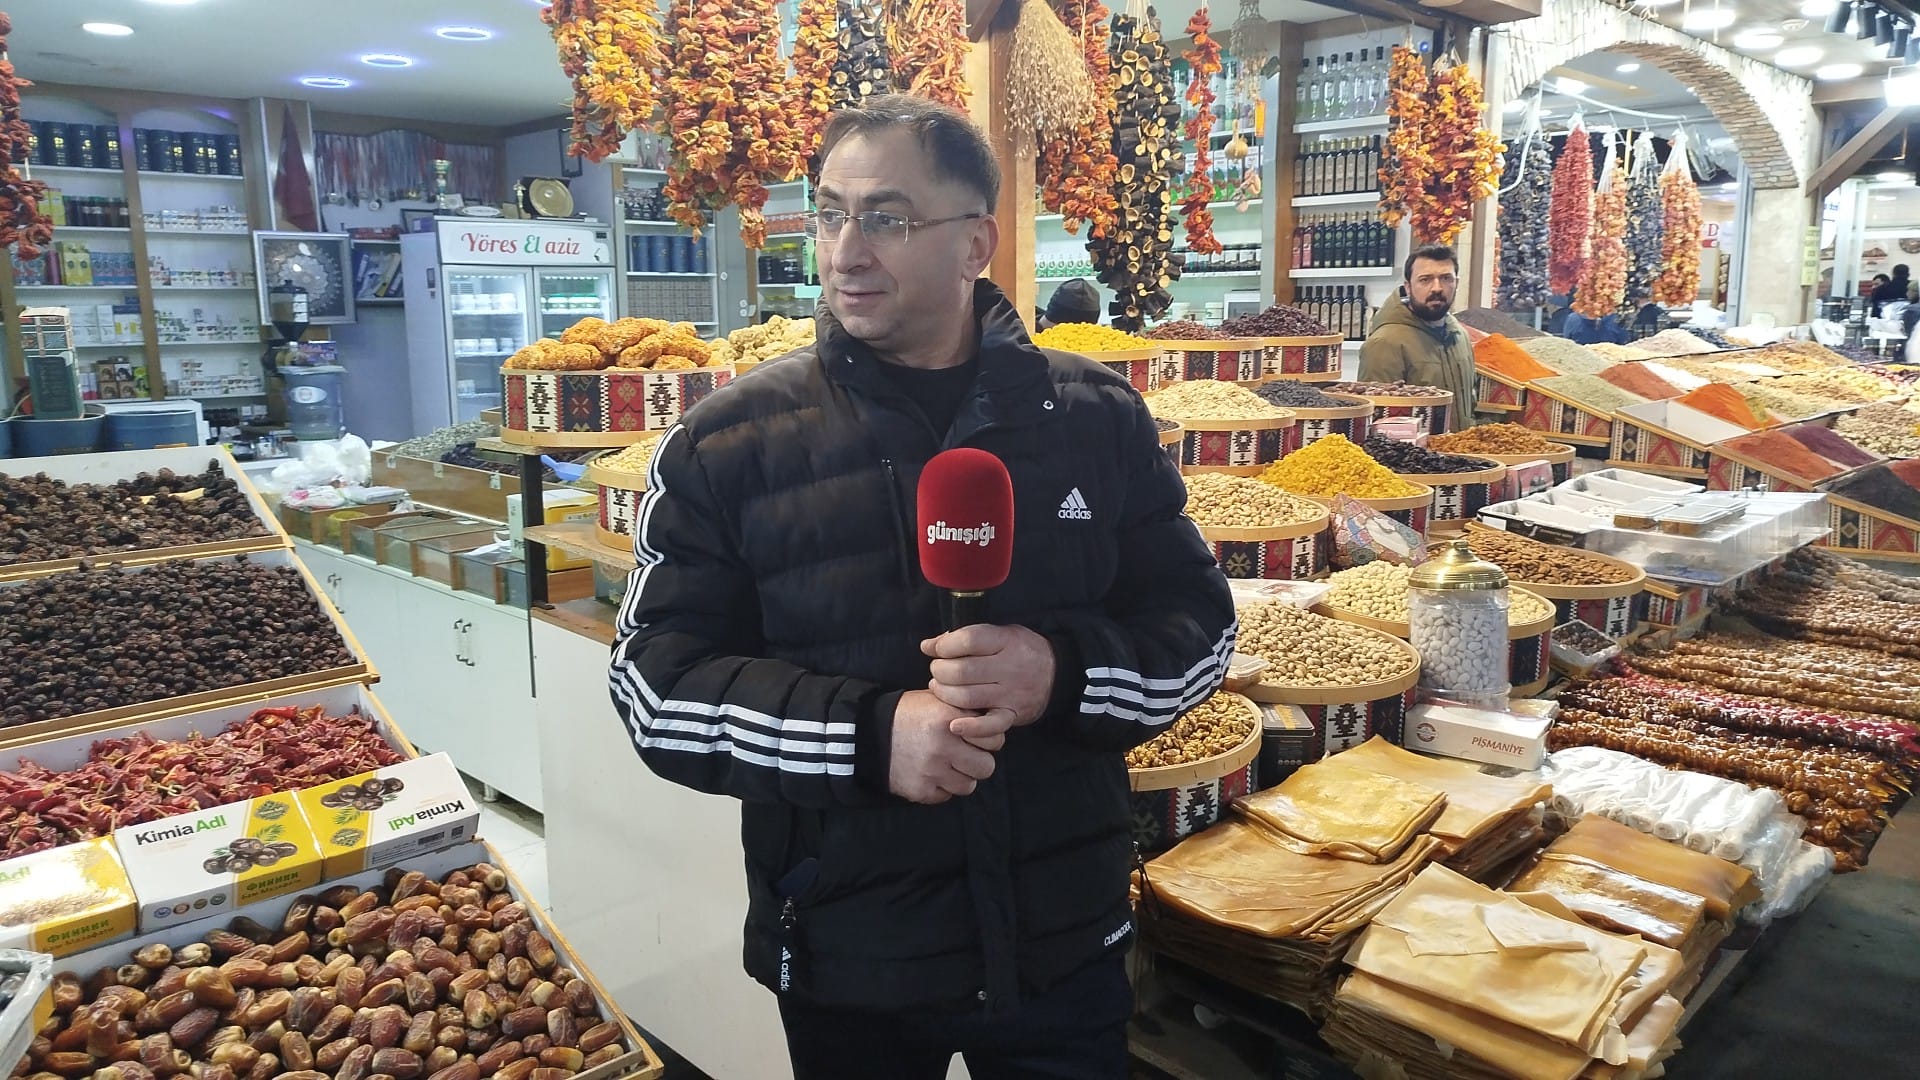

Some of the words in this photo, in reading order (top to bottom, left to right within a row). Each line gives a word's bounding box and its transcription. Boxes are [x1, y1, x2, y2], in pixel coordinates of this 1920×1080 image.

[461, 232, 517, 254] Yöres
[524, 234, 541, 254] El
[545, 237, 581, 256] aziz
[1057, 508, 1092, 520] adidas
[927, 520, 995, 547] günışığı
[1471, 736, 1526, 755] PİŞMANİYE
